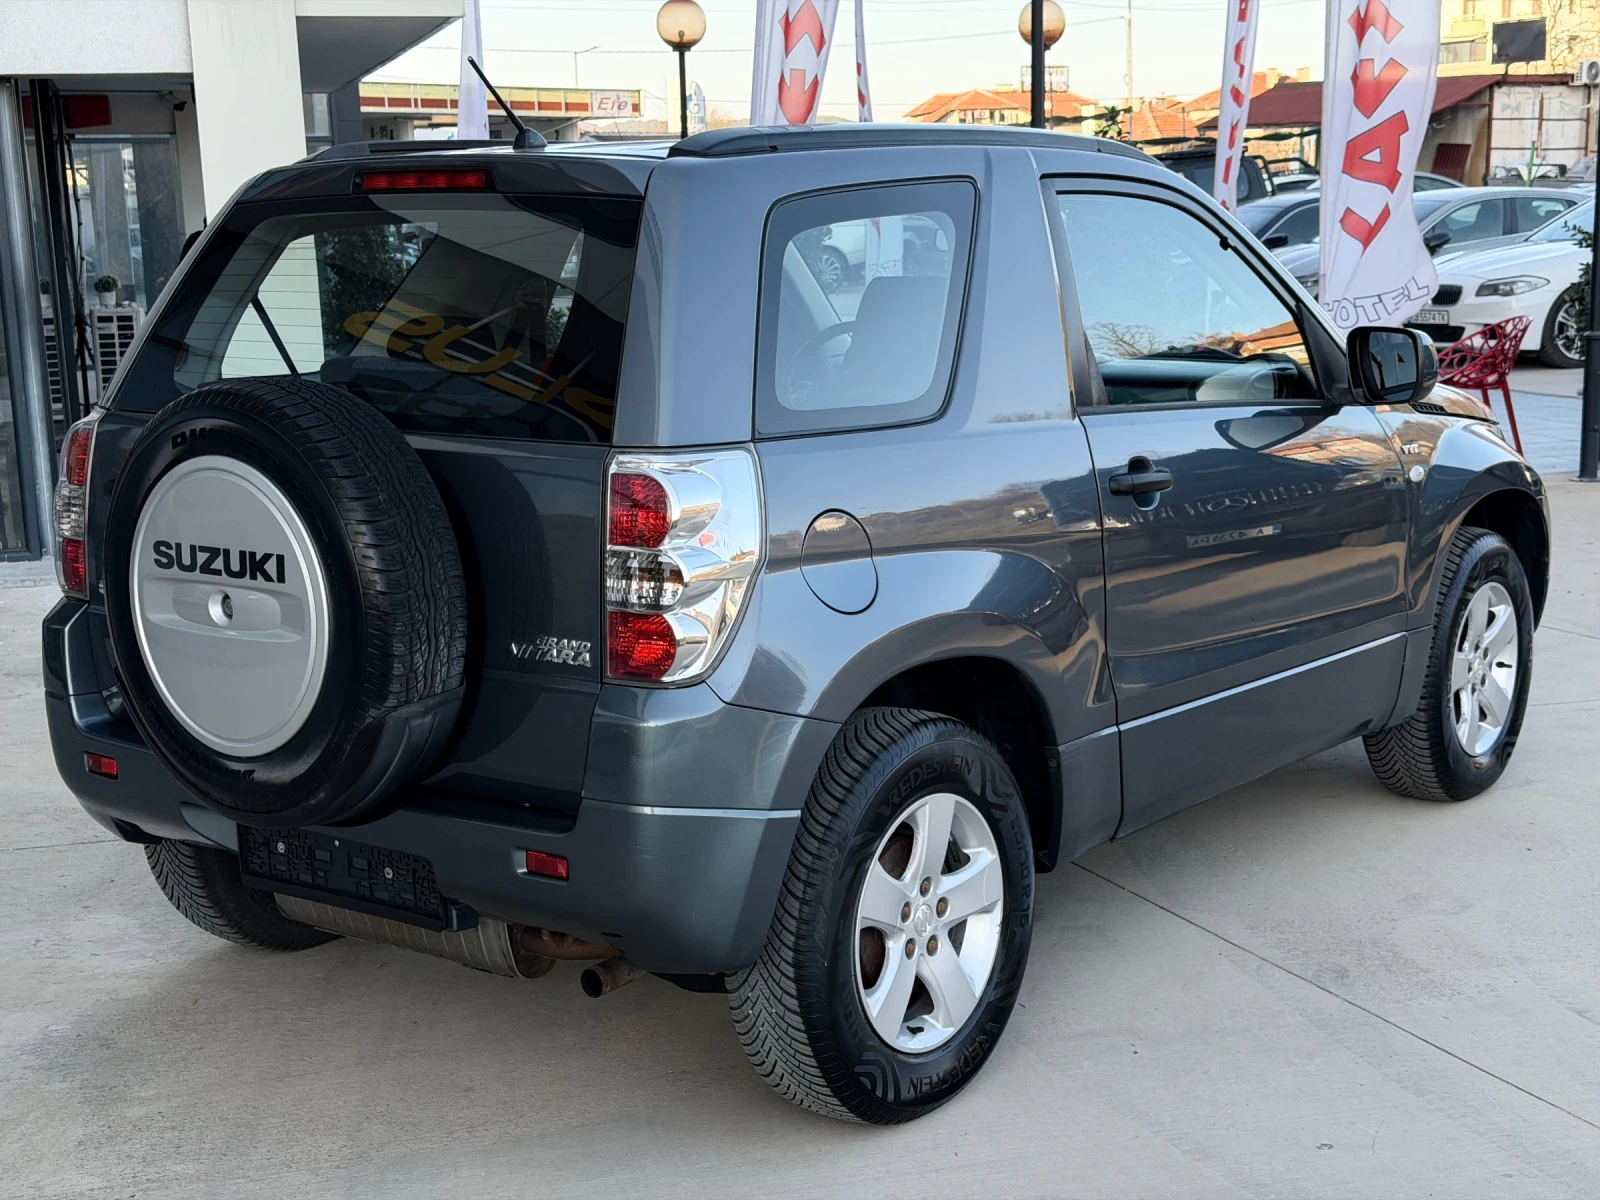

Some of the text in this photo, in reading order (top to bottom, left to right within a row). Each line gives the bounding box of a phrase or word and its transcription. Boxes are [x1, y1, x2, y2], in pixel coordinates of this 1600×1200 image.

[152, 540, 286, 584] SUZUKI
[510, 643, 592, 667] VITARA
[537, 636, 591, 653] GRAND
